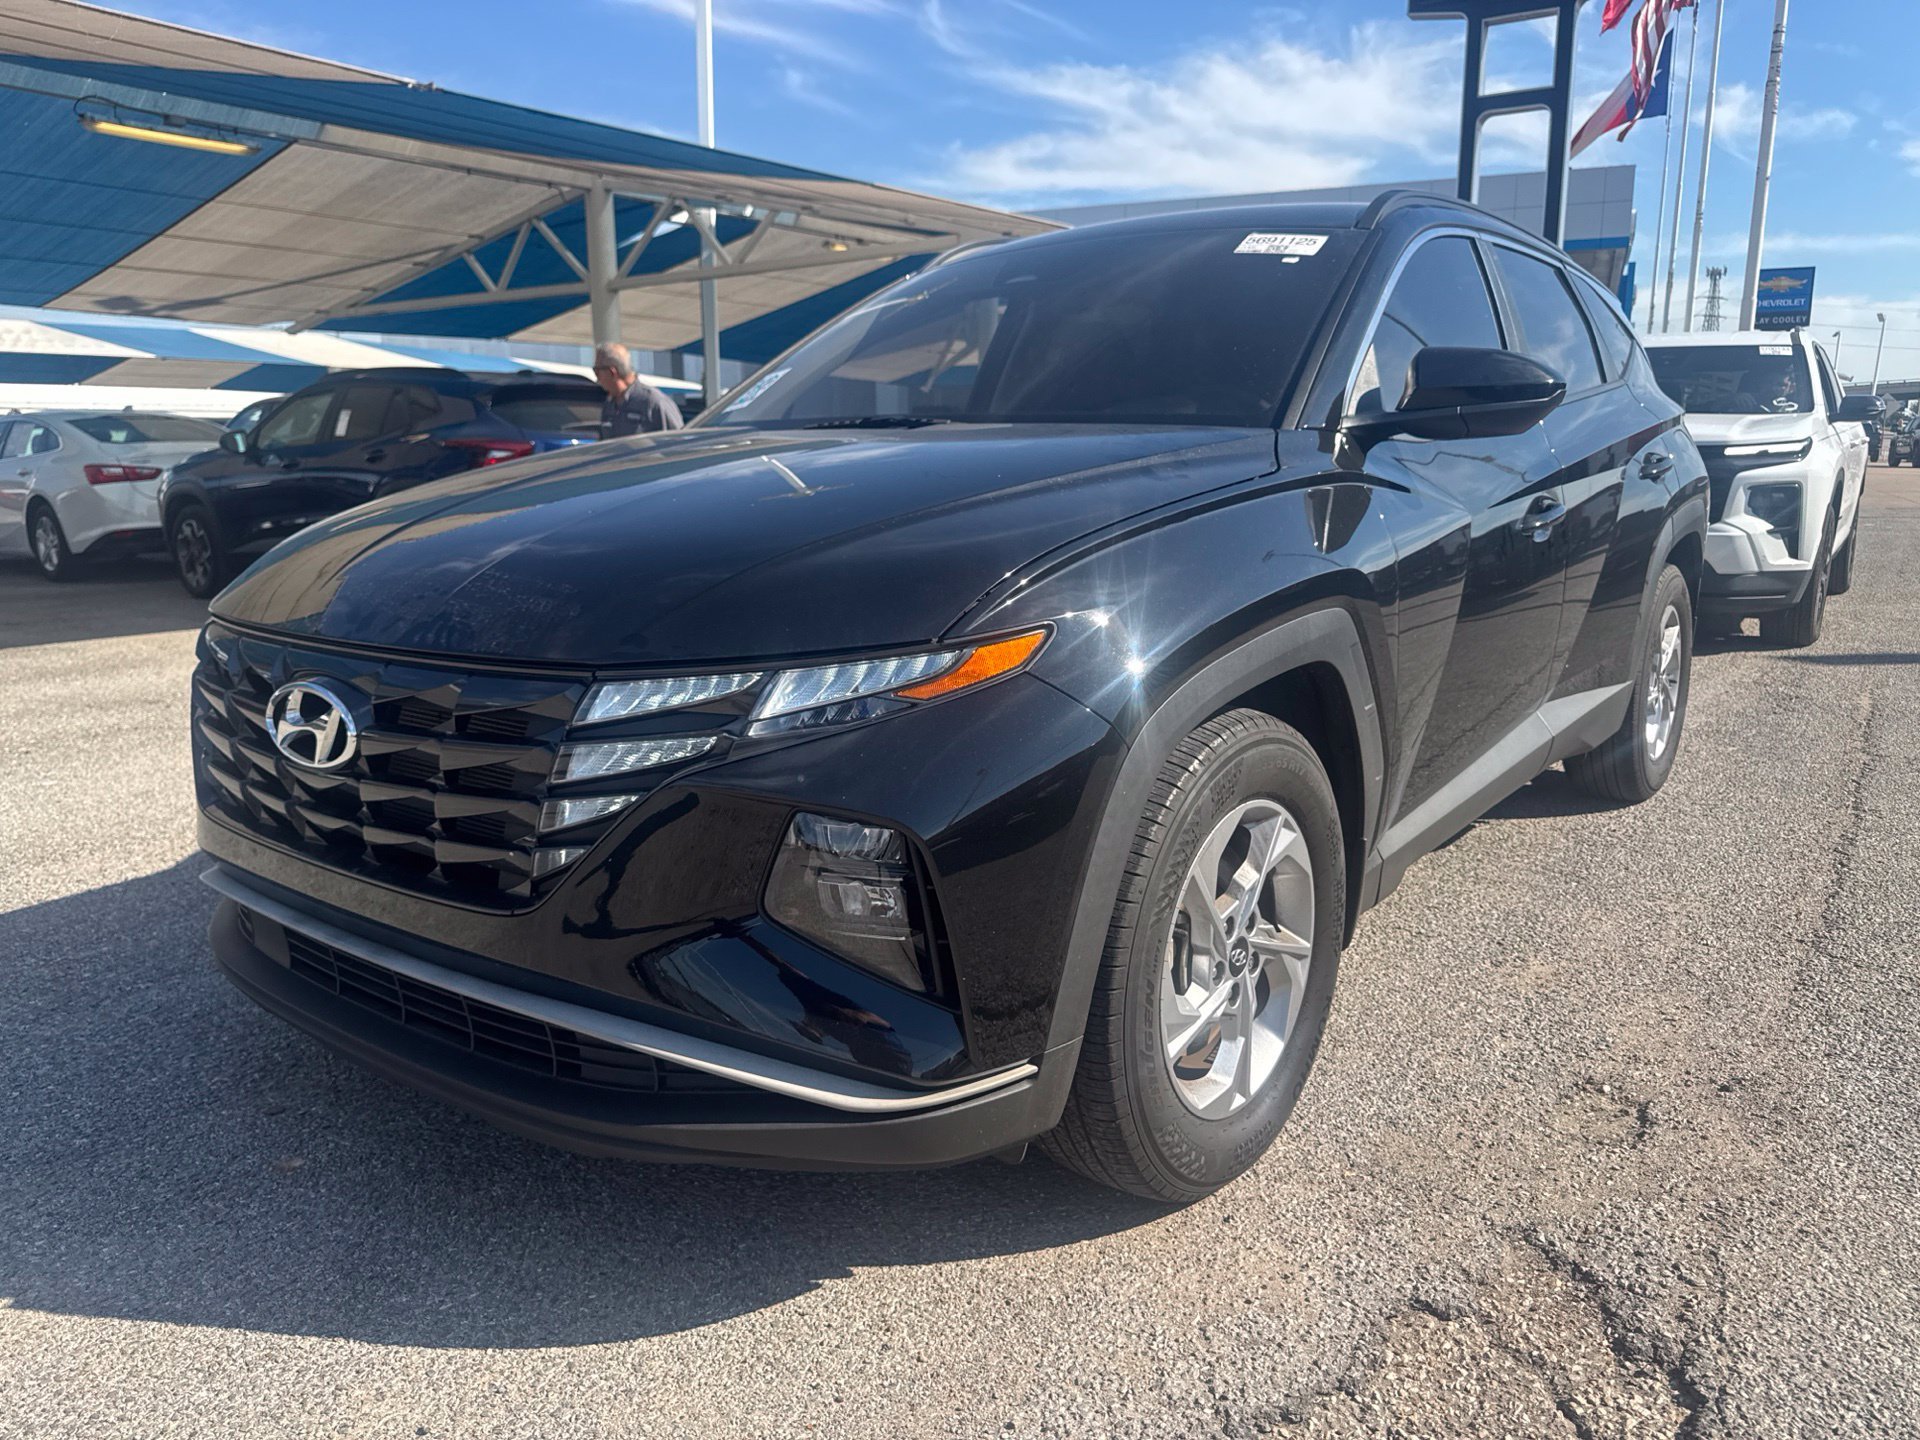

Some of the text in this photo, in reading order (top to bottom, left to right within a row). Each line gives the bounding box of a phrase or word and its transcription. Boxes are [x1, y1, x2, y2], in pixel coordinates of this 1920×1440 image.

[1245, 236, 1319, 246] 5691125
[1757, 298, 1806, 307] HEVROLET
[1772, 315, 1807, 324] COOLEY
